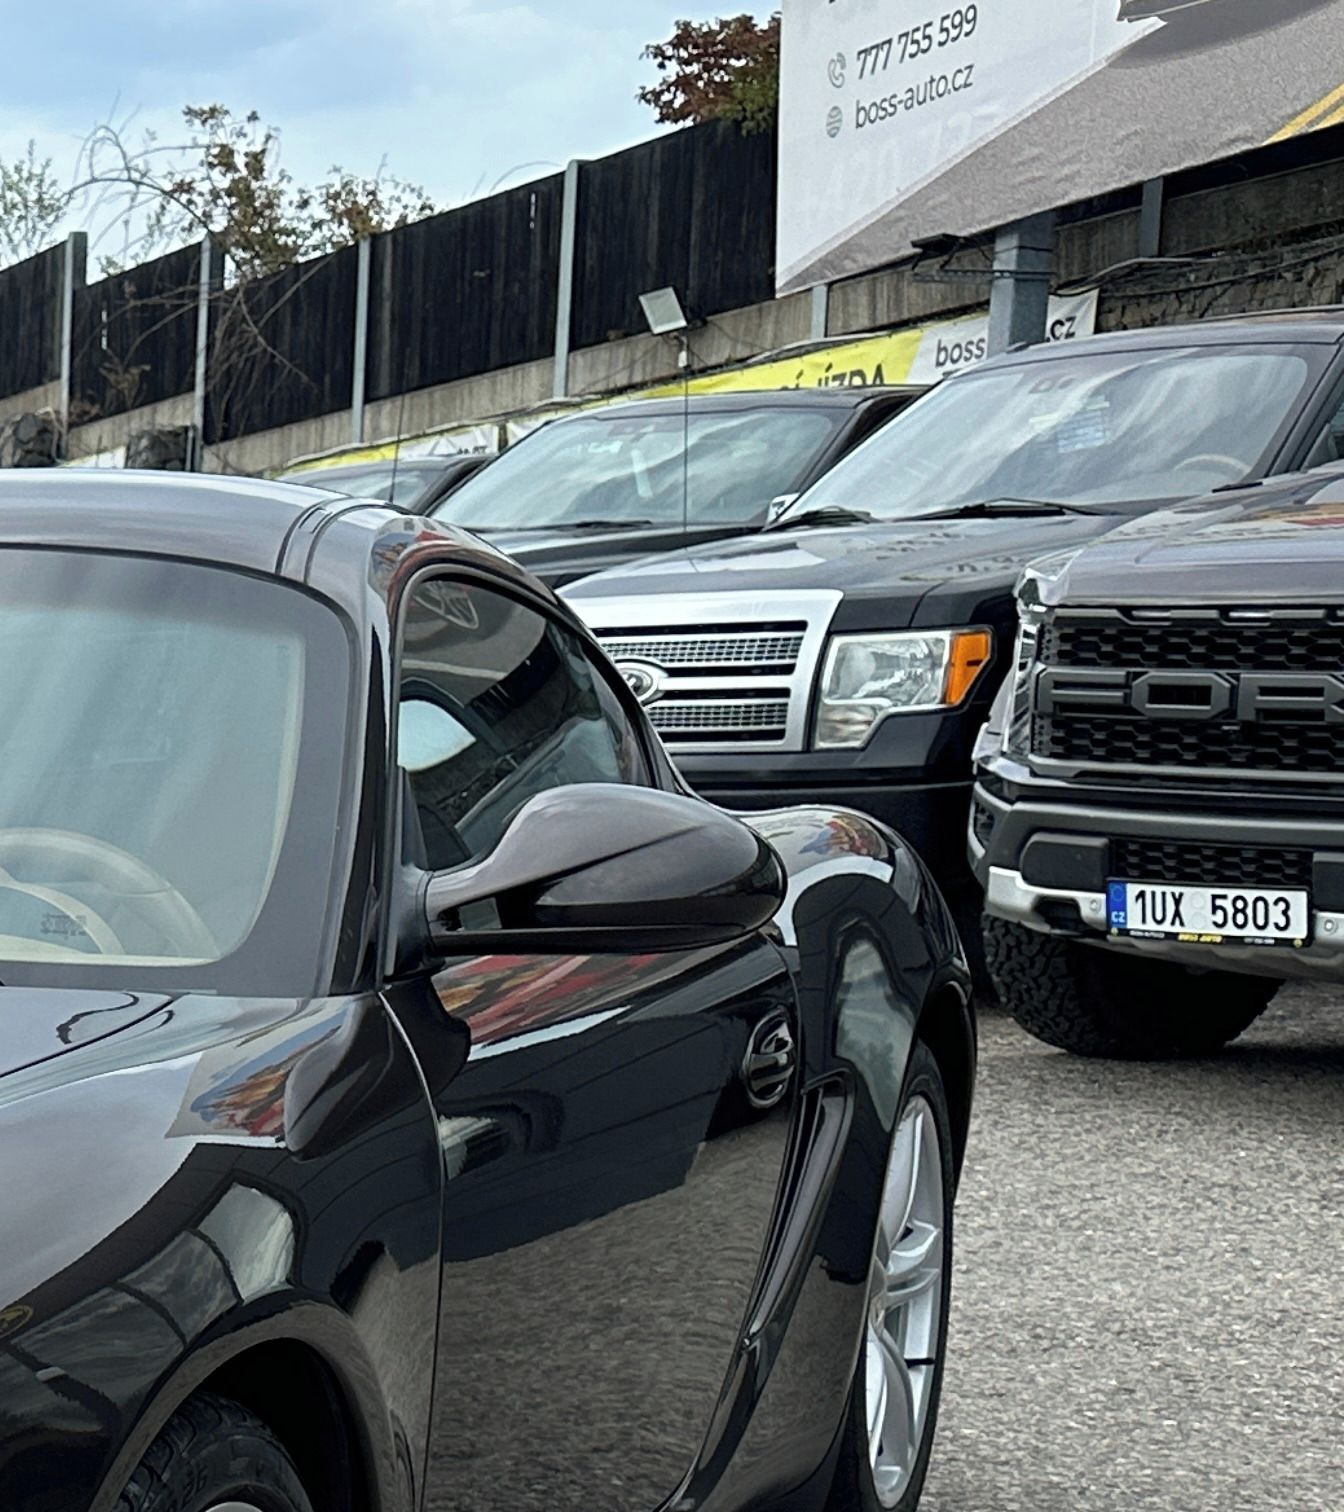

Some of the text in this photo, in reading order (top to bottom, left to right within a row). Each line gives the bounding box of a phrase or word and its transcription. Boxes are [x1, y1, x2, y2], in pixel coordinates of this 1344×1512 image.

[856, 4, 978, 80] 777 755 599
[855, 63, 975, 129] boss-auto.cz
[1111, 911, 1126, 923] CZ
[1135, 890, 1292, 931] 1UX 5803
